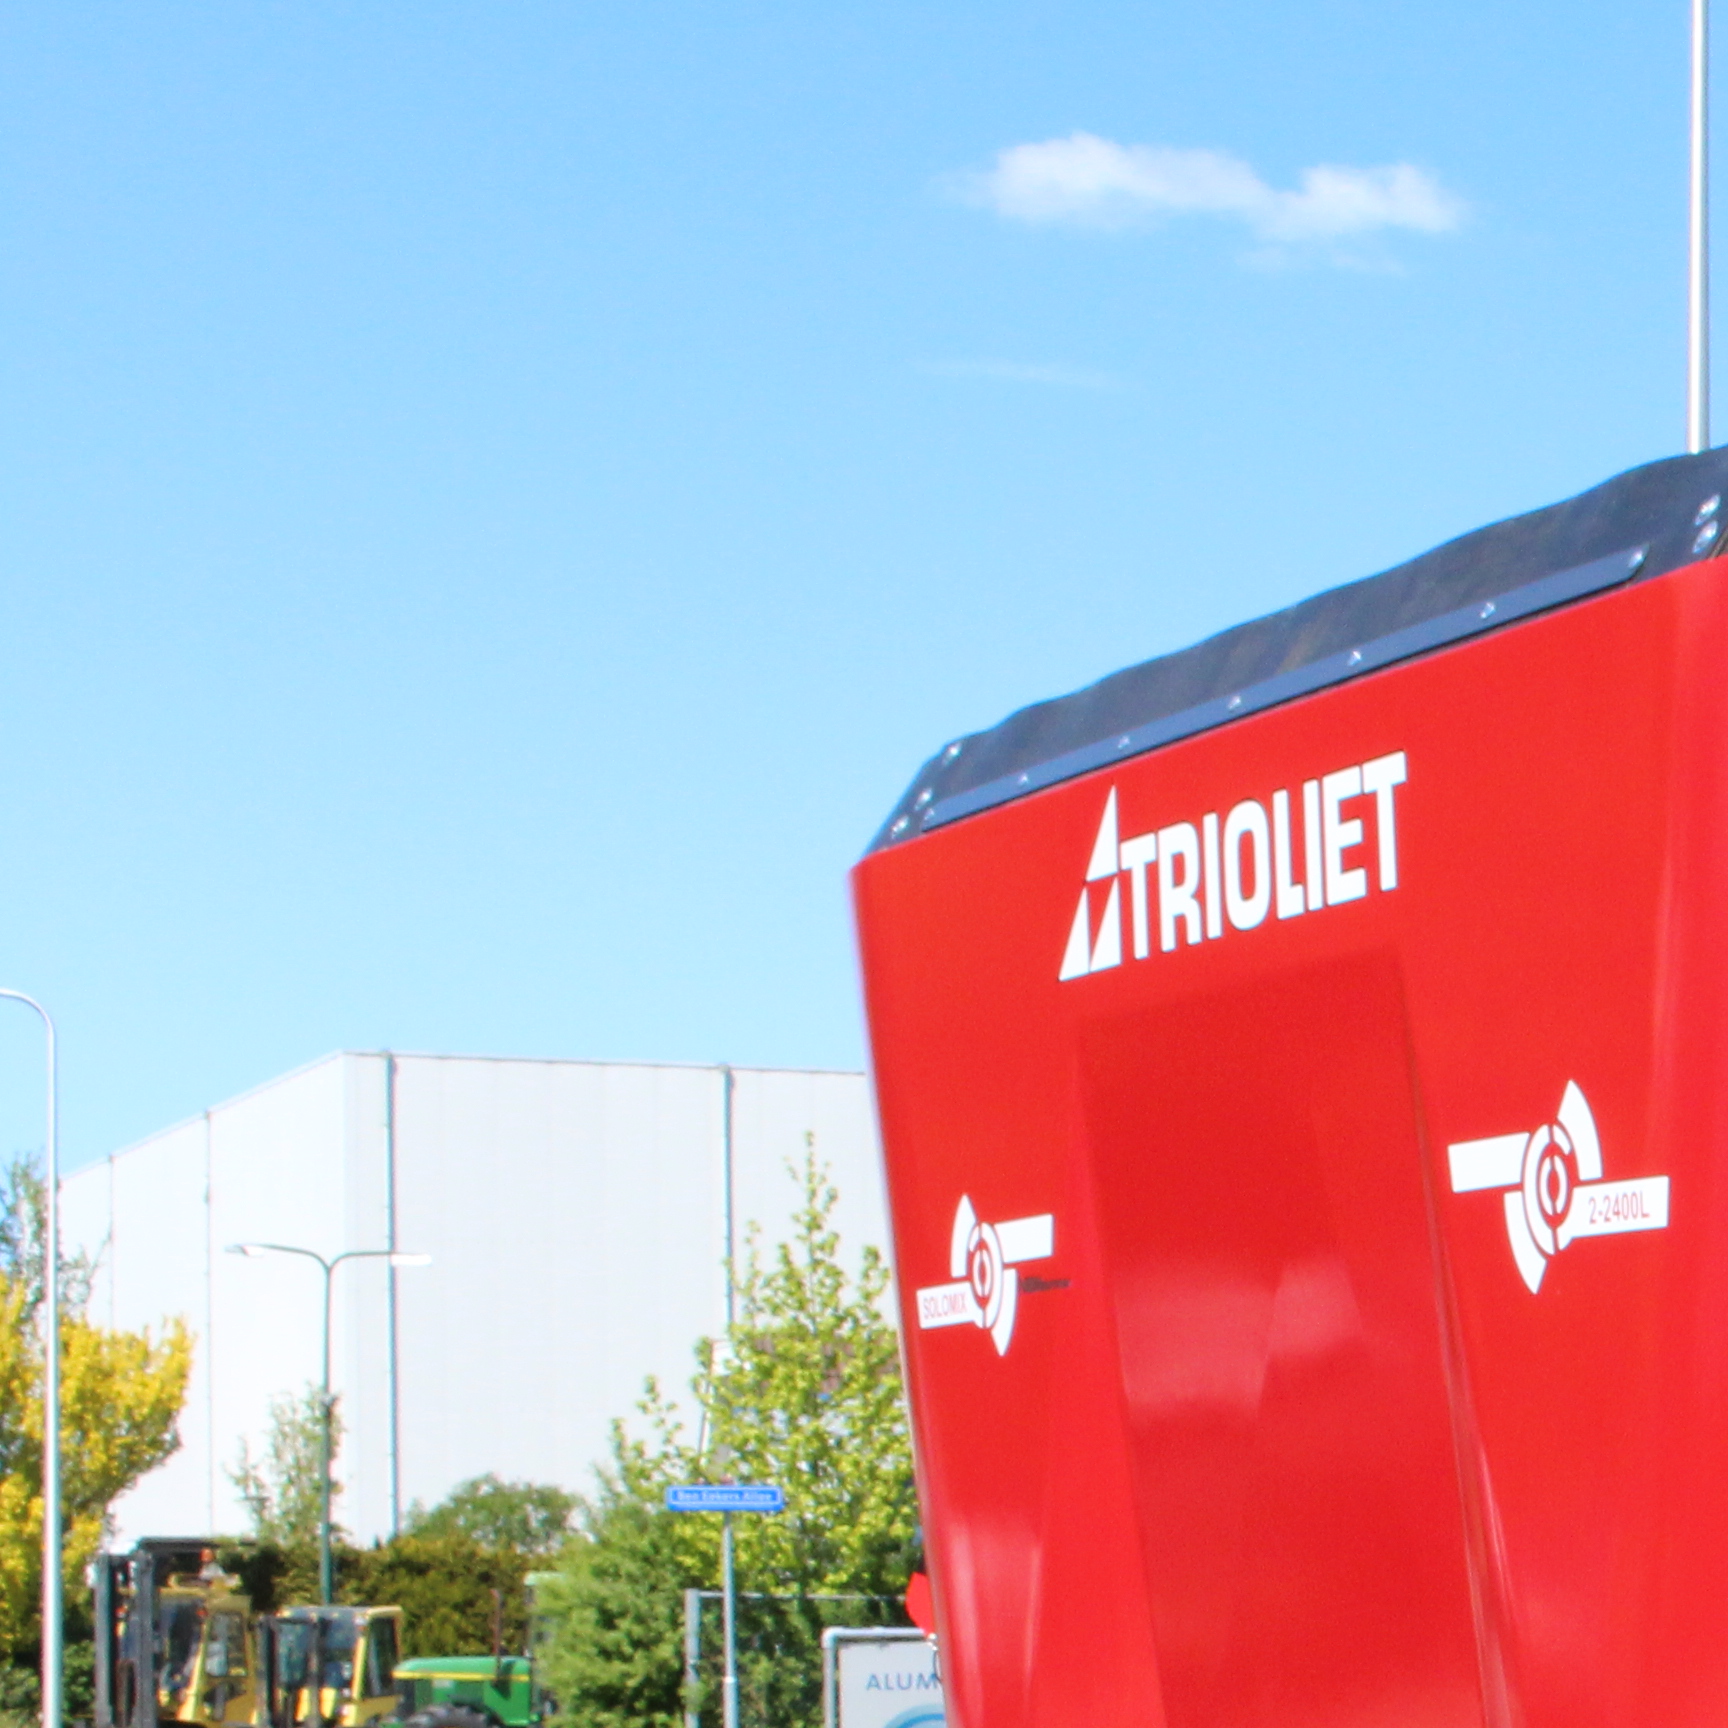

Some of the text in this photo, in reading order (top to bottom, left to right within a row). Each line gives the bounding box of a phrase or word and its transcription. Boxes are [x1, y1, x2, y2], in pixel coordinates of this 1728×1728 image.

[1119, 750, 1407, 960] TRIOLIET
[1587, 1190, 1650, 1225] 2-2400L
[923, 1292, 968, 1320] SOLOMIX
